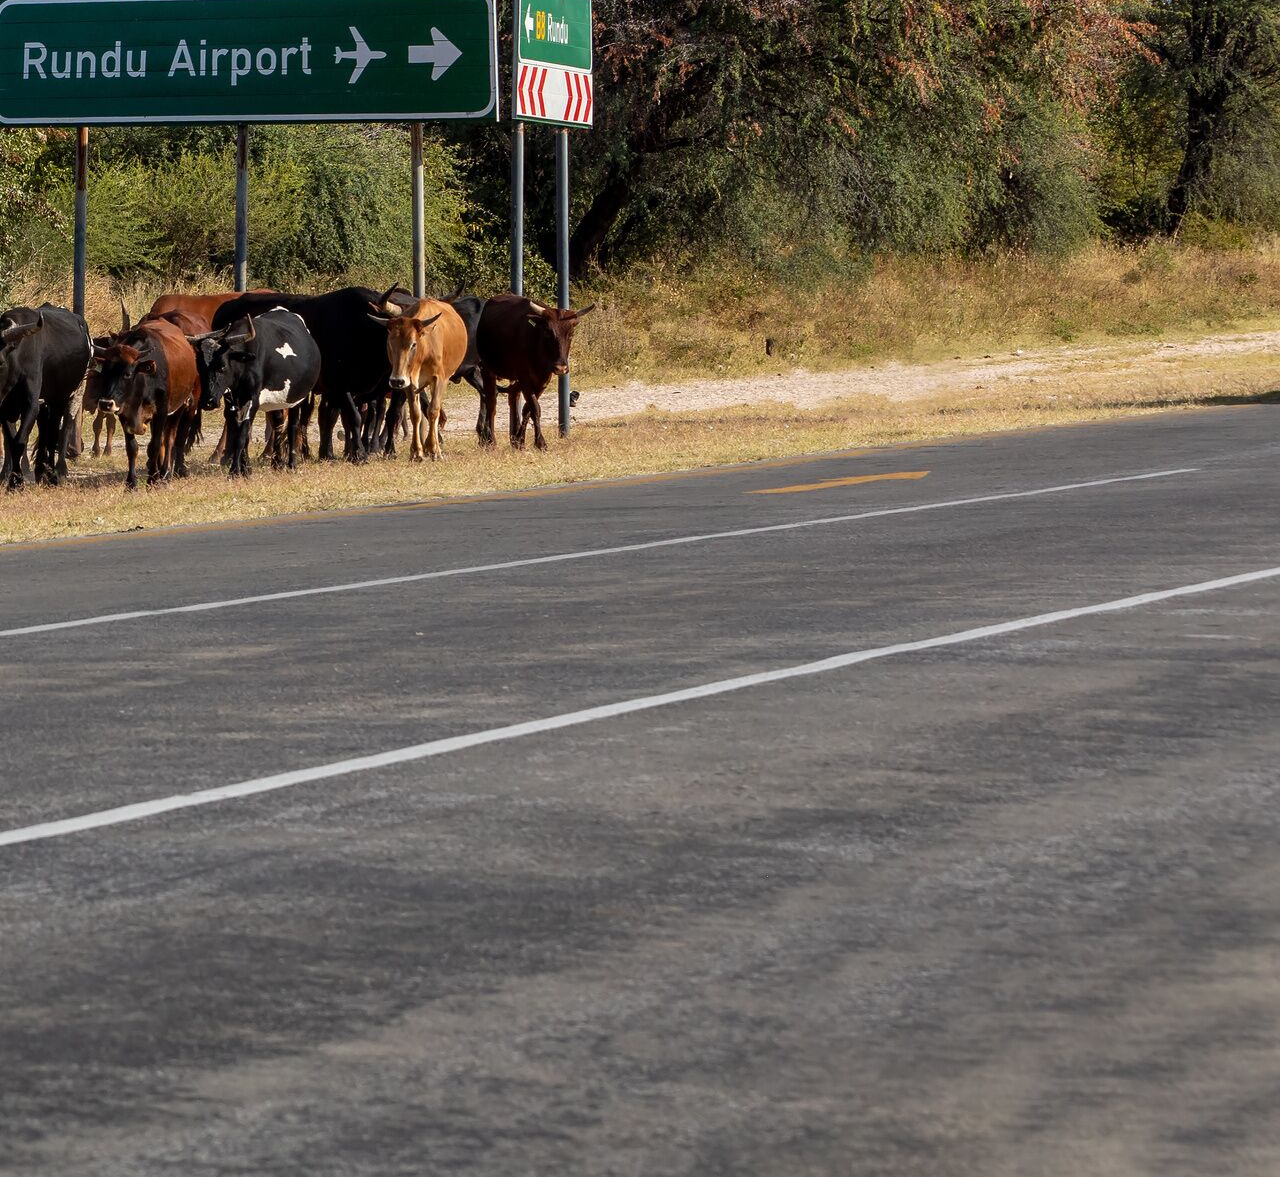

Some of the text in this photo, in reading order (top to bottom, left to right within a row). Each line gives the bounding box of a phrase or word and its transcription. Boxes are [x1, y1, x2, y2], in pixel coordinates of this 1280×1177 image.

[536, 10, 569, 44] B8 Rundu
[23, 37, 312, 86] Rundu Airport
